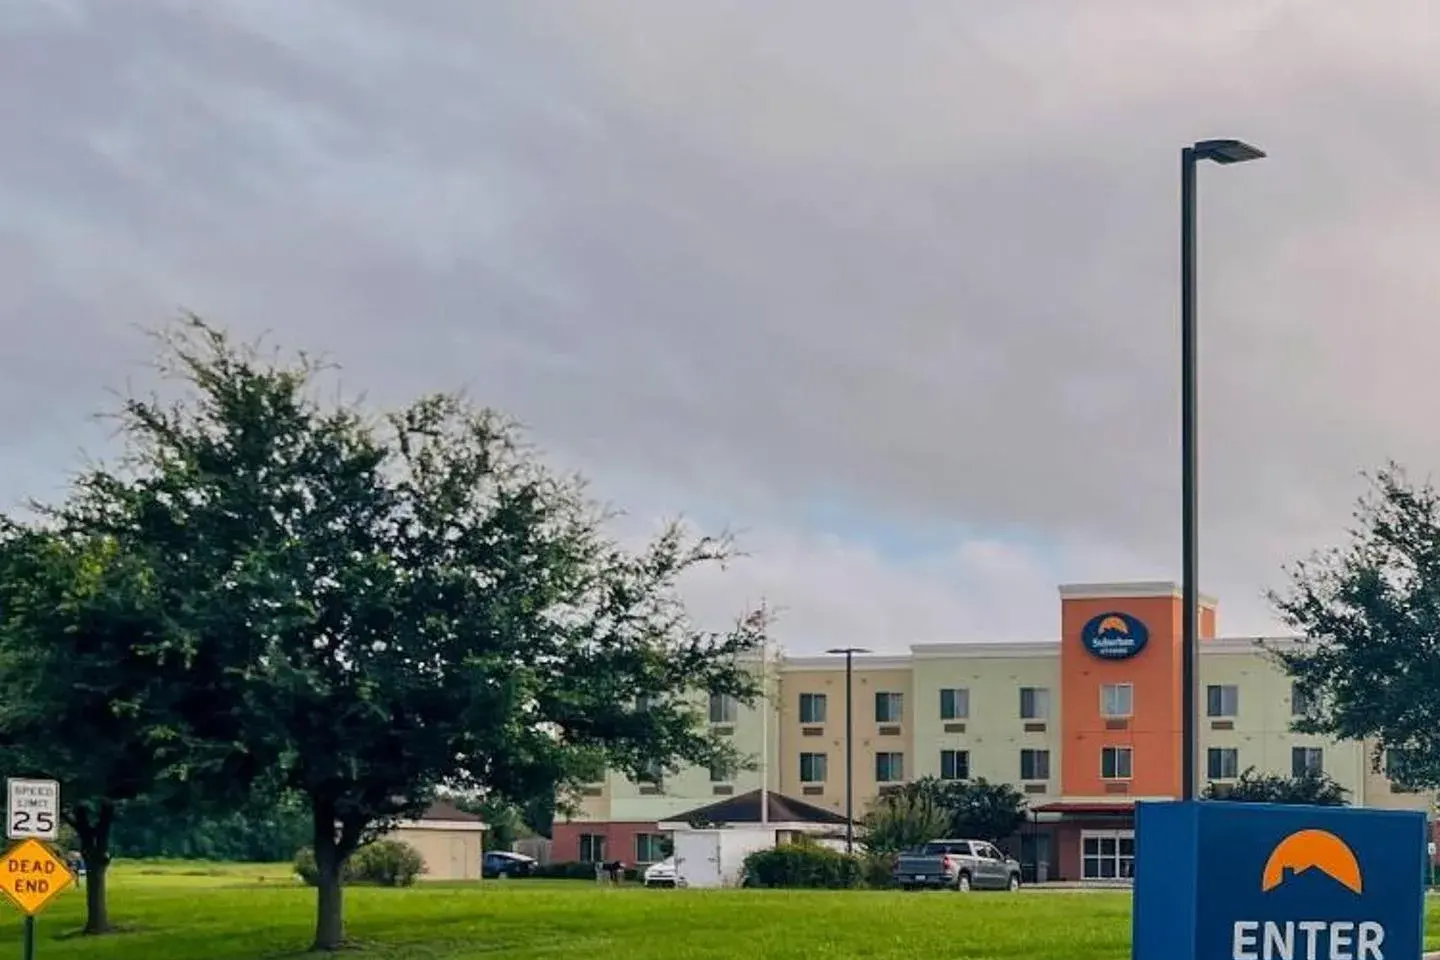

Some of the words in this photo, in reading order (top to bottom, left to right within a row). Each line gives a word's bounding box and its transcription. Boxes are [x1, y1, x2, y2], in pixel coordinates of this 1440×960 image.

[14, 785, 54, 796] SPEED
[13, 811, 54, 832] 25
[8, 859, 55, 874] DEAD
[14, 879, 49, 894] END
